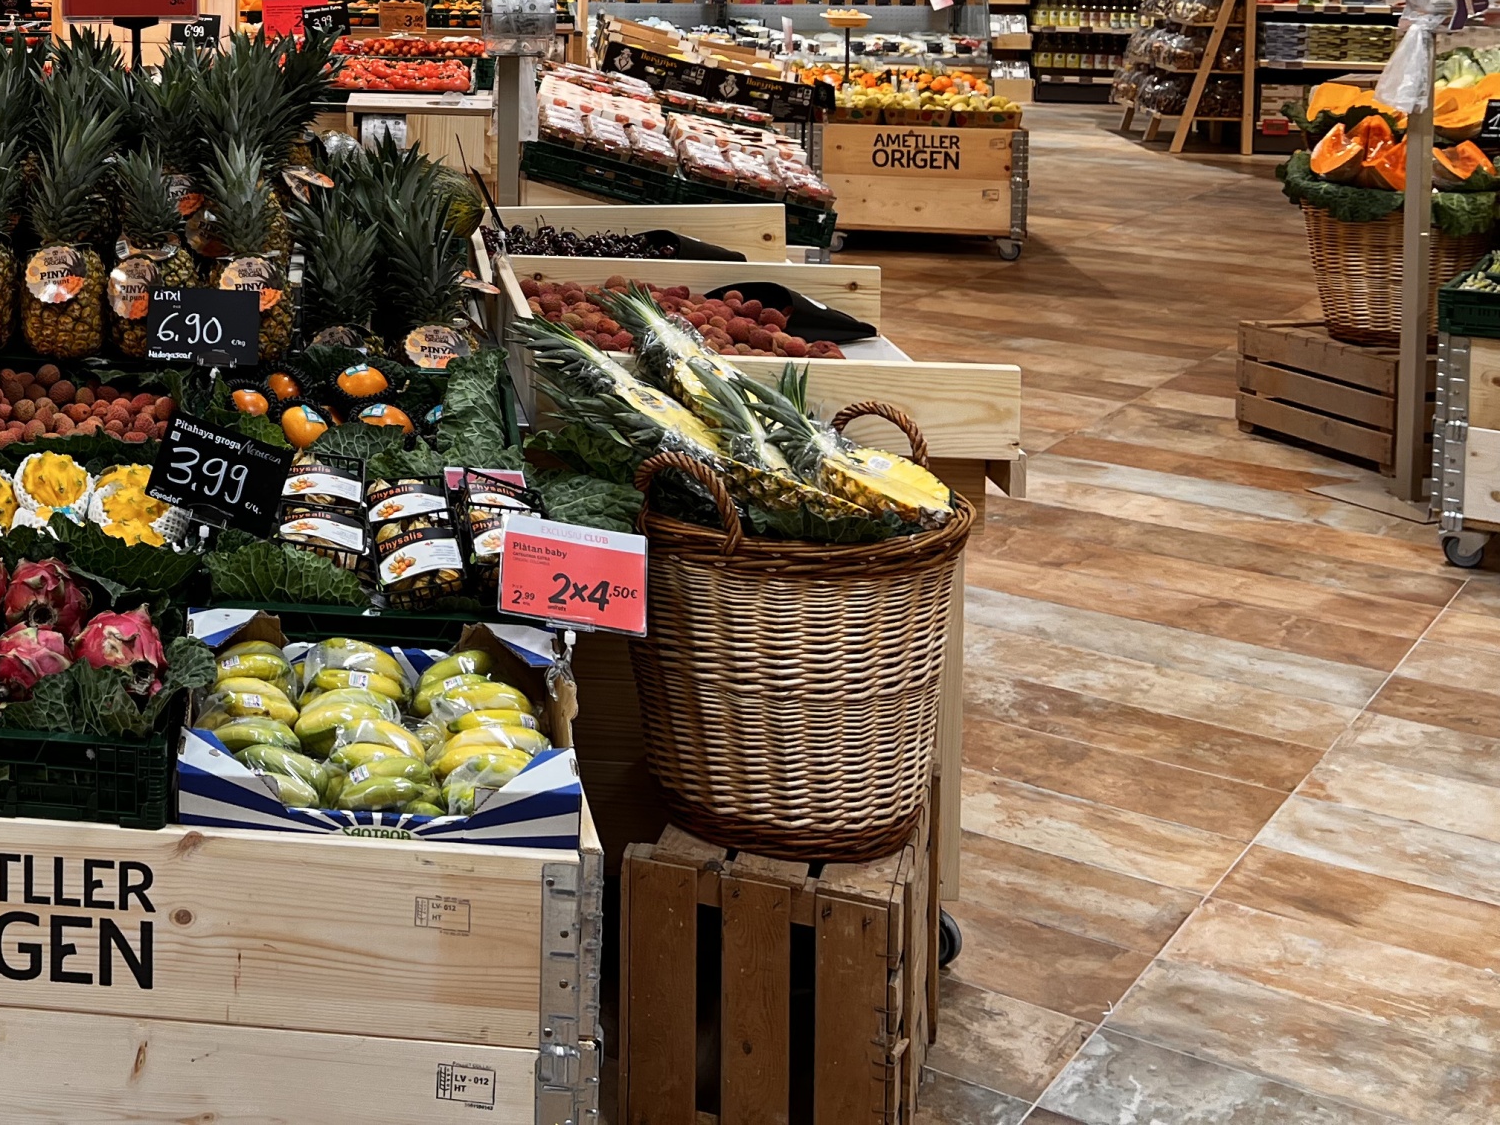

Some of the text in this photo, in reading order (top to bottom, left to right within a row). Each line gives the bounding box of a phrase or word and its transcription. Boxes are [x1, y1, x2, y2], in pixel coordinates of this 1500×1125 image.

[873, 133, 961, 150] AMETLLER
[872, 149, 961, 170] ORIGEN
[120, 285, 149, 294] PINYA
[148, 350, 193, 361] Madagascar
[175, 418, 241, 451] Pitahaya groga
[370, 484, 416, 502] Physalis
[469, 482, 516, 498] Physalis
[284, 511, 332, 521] Physalis
[378, 531, 424, 554] Physalis
[541, 525, 609, 545] EXCLUSIU CLUB
[513, 541, 568, 559] Plàtan baby
[431, 914, 442, 922] HT
[454, 1074, 489, 1087] LV 012
[454, 1084, 467, 1094] HT
